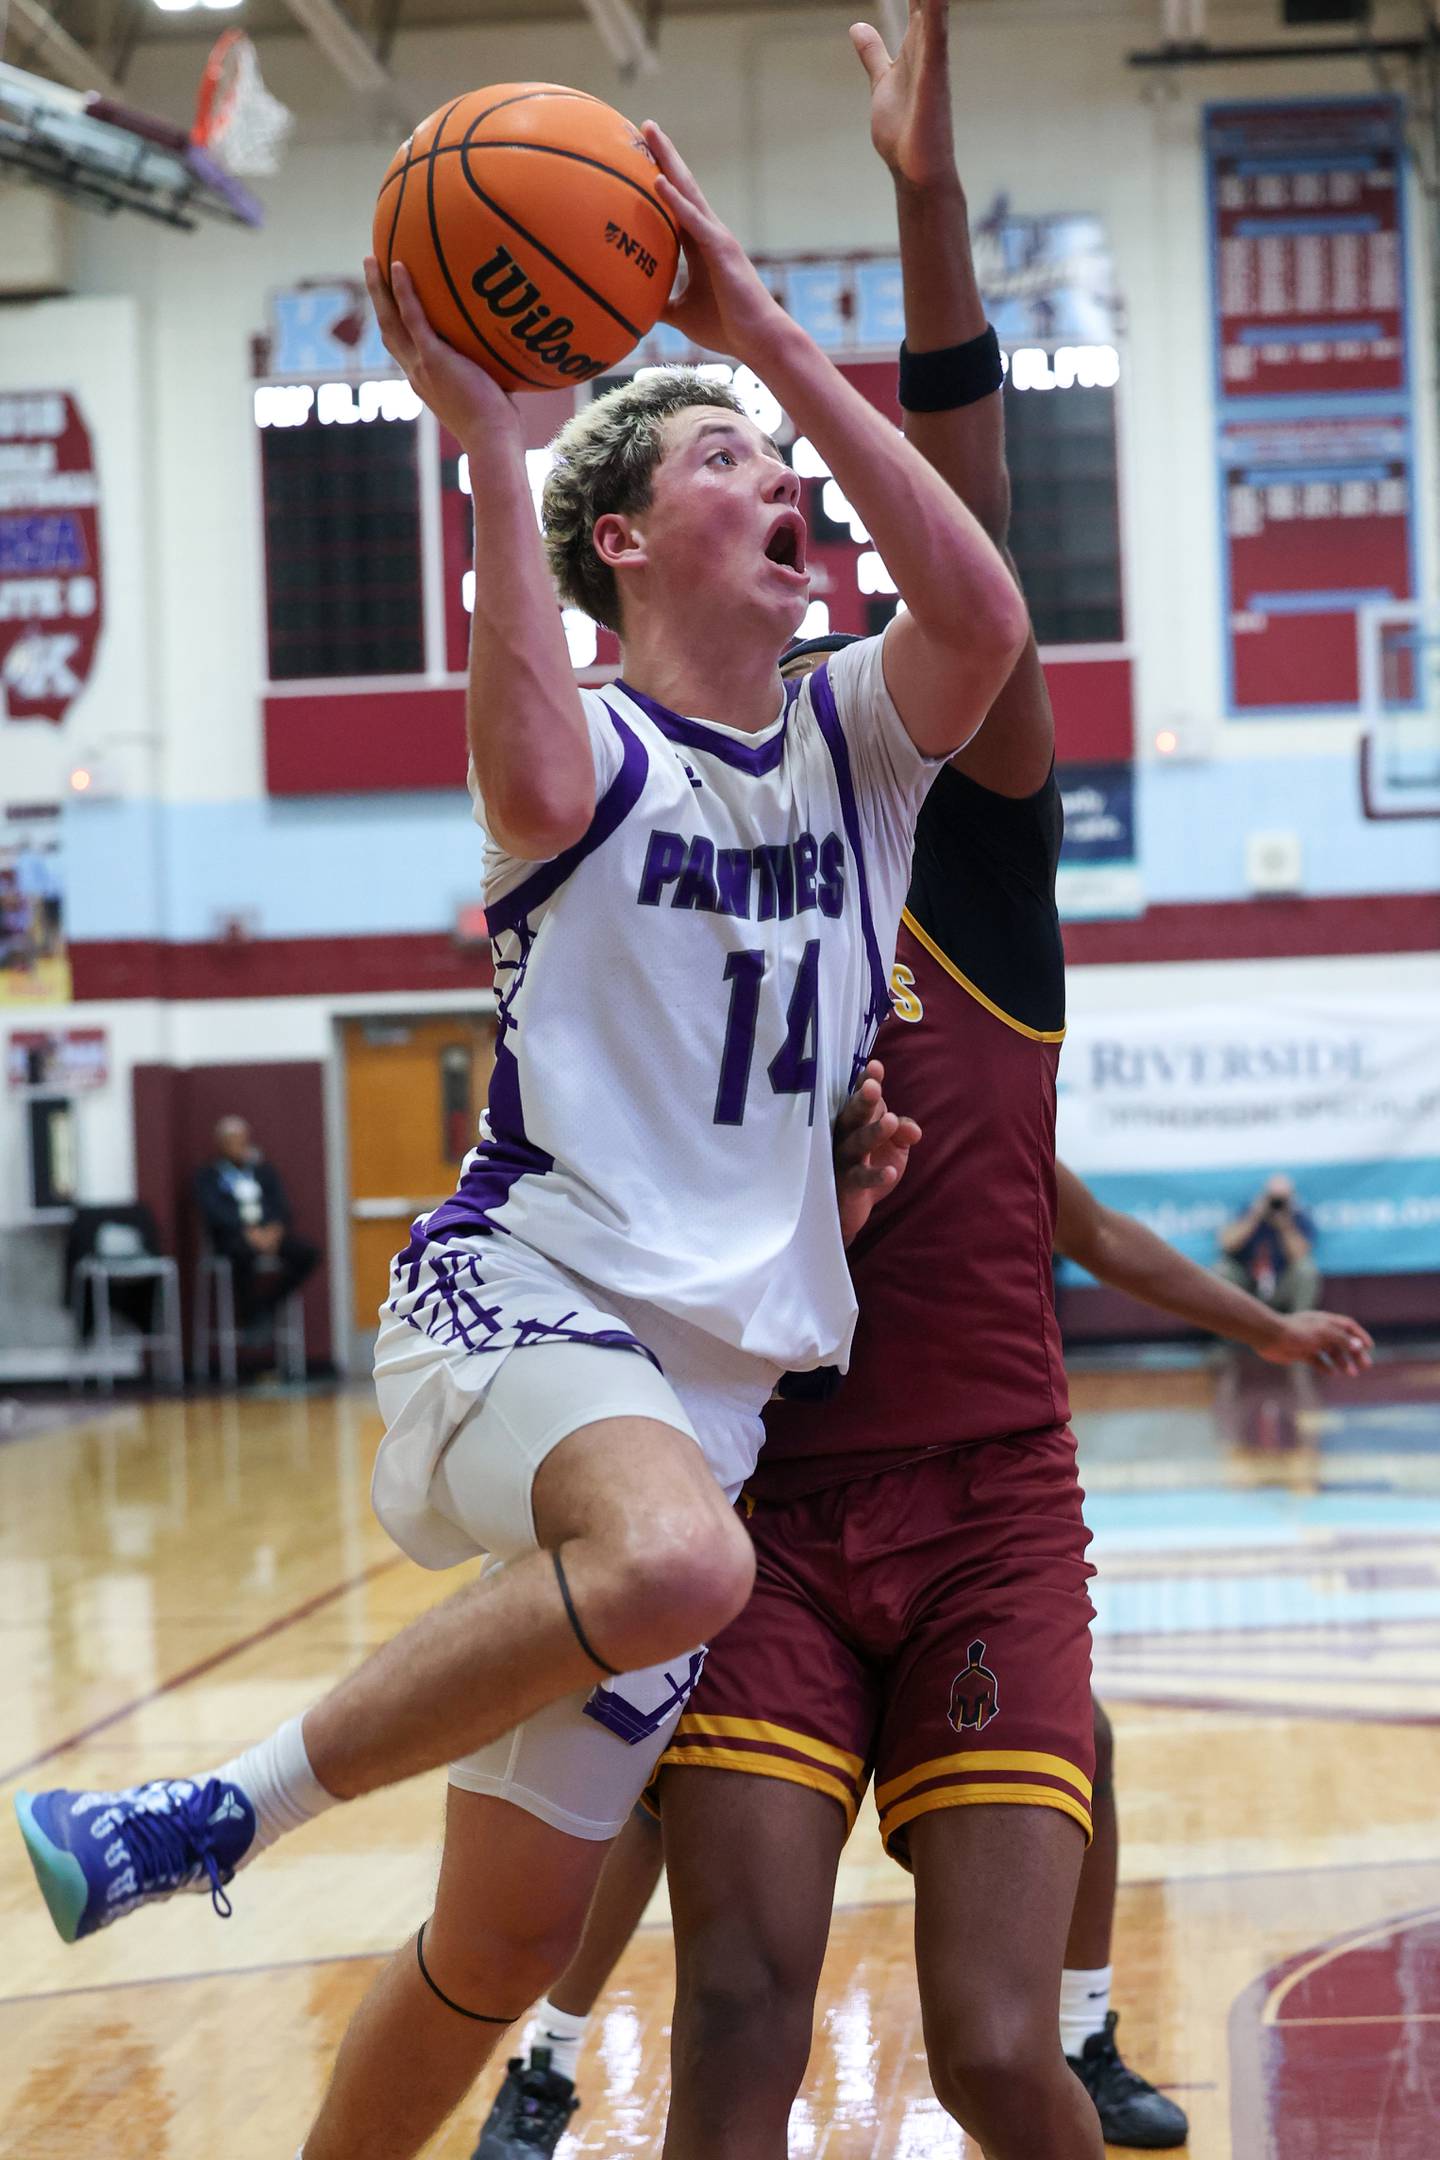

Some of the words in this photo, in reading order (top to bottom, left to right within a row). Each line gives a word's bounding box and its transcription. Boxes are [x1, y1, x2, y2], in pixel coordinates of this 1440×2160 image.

[616, 232, 658, 279] NFHS
[472, 245, 609, 381] Wilson
[637, 829, 845, 922] PANTES
[713, 938, 820, 1126] 14
